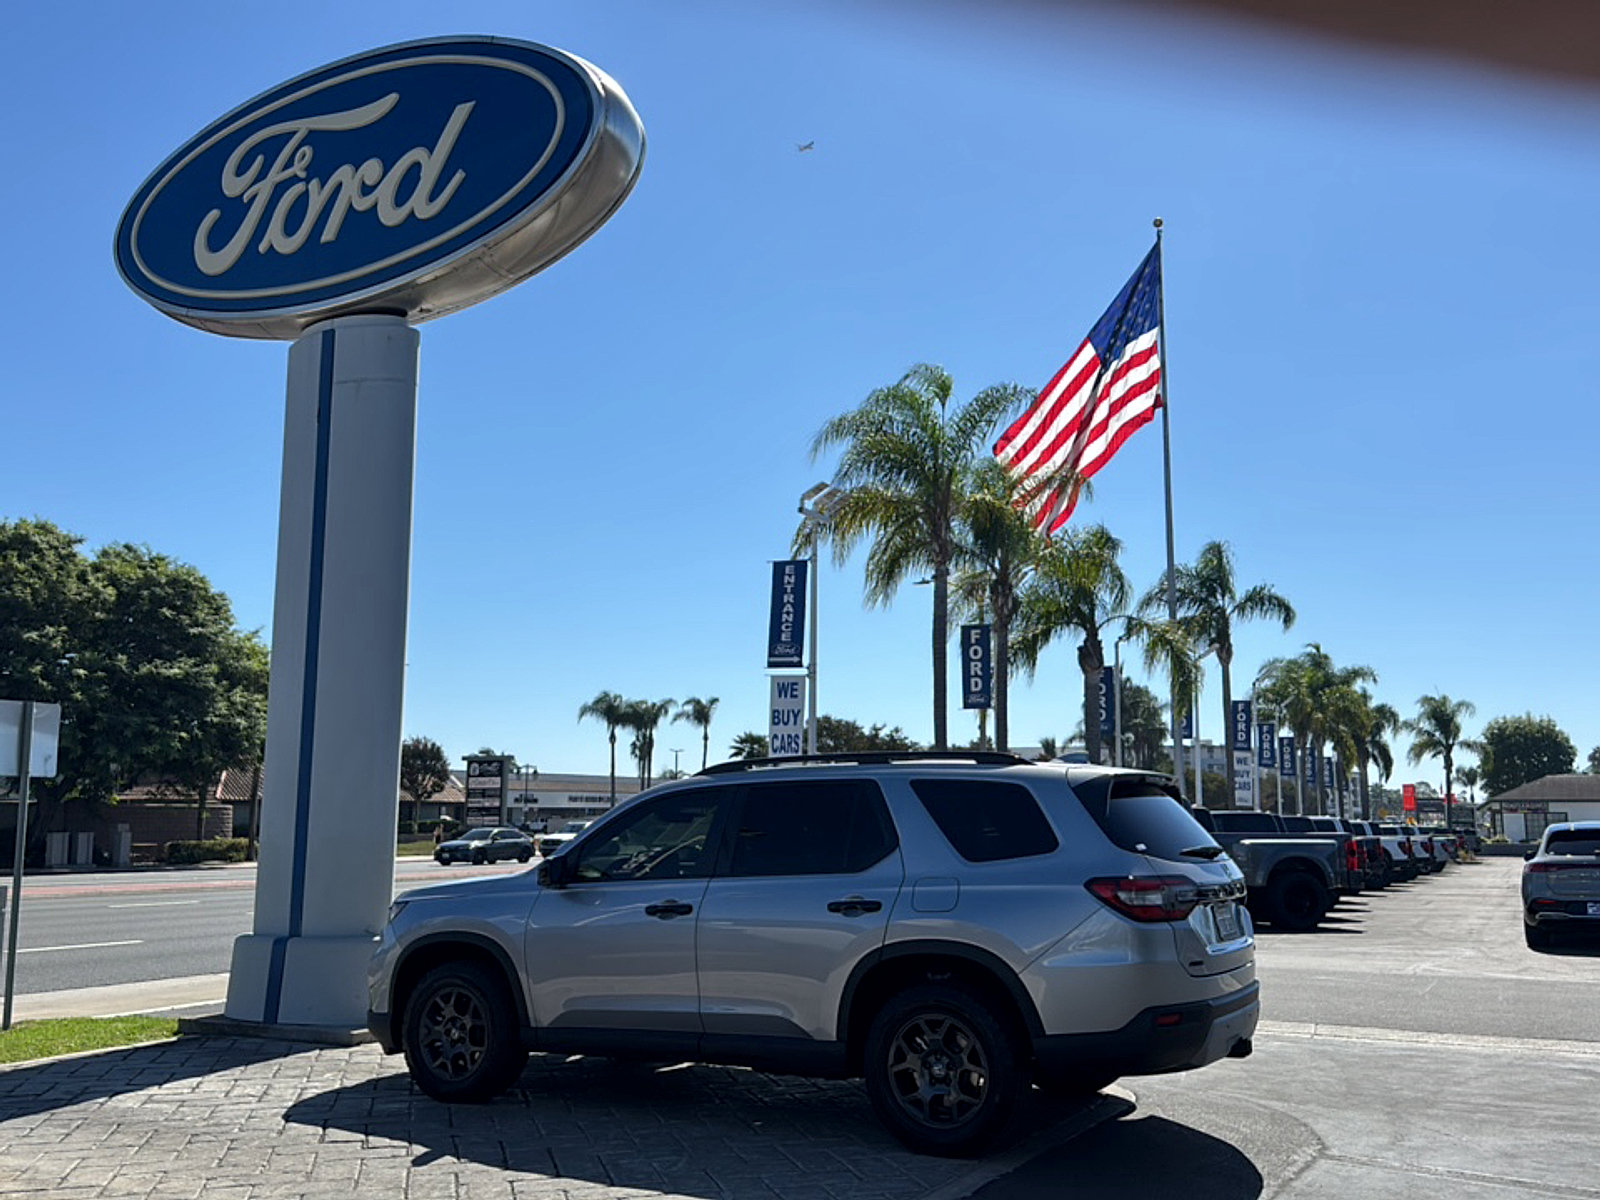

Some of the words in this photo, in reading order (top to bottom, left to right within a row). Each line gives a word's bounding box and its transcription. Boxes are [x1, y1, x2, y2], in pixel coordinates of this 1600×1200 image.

[193, 91, 477, 276] Ford
[781, 564, 795, 642] ENTRANCE
[968, 630, 984, 692] FORD
[776, 681, 800, 698] WE
[771, 708, 801, 726] BUY
[1236, 703, 1247, 741] FORD
[771, 733, 800, 754] CARS
[1261, 725, 1271, 758] FORD
